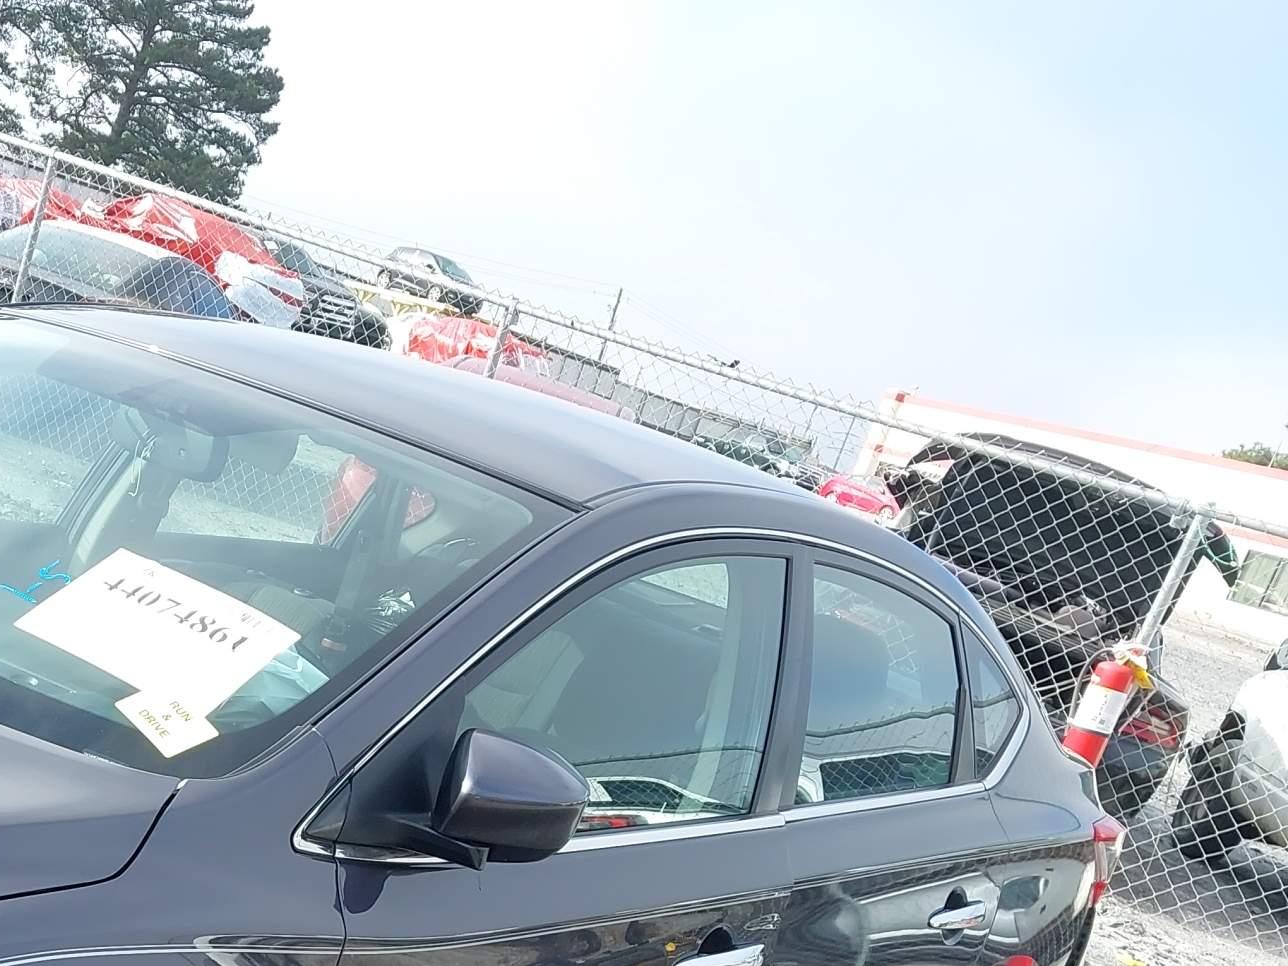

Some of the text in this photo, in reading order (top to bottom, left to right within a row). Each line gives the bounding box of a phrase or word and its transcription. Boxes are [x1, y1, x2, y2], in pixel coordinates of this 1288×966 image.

[103, 577, 249, 652] 44074861
[138, 709, 170, 738] DRIVE
[161, 713, 172, 721] &
[169, 700, 192, 722] RUN
